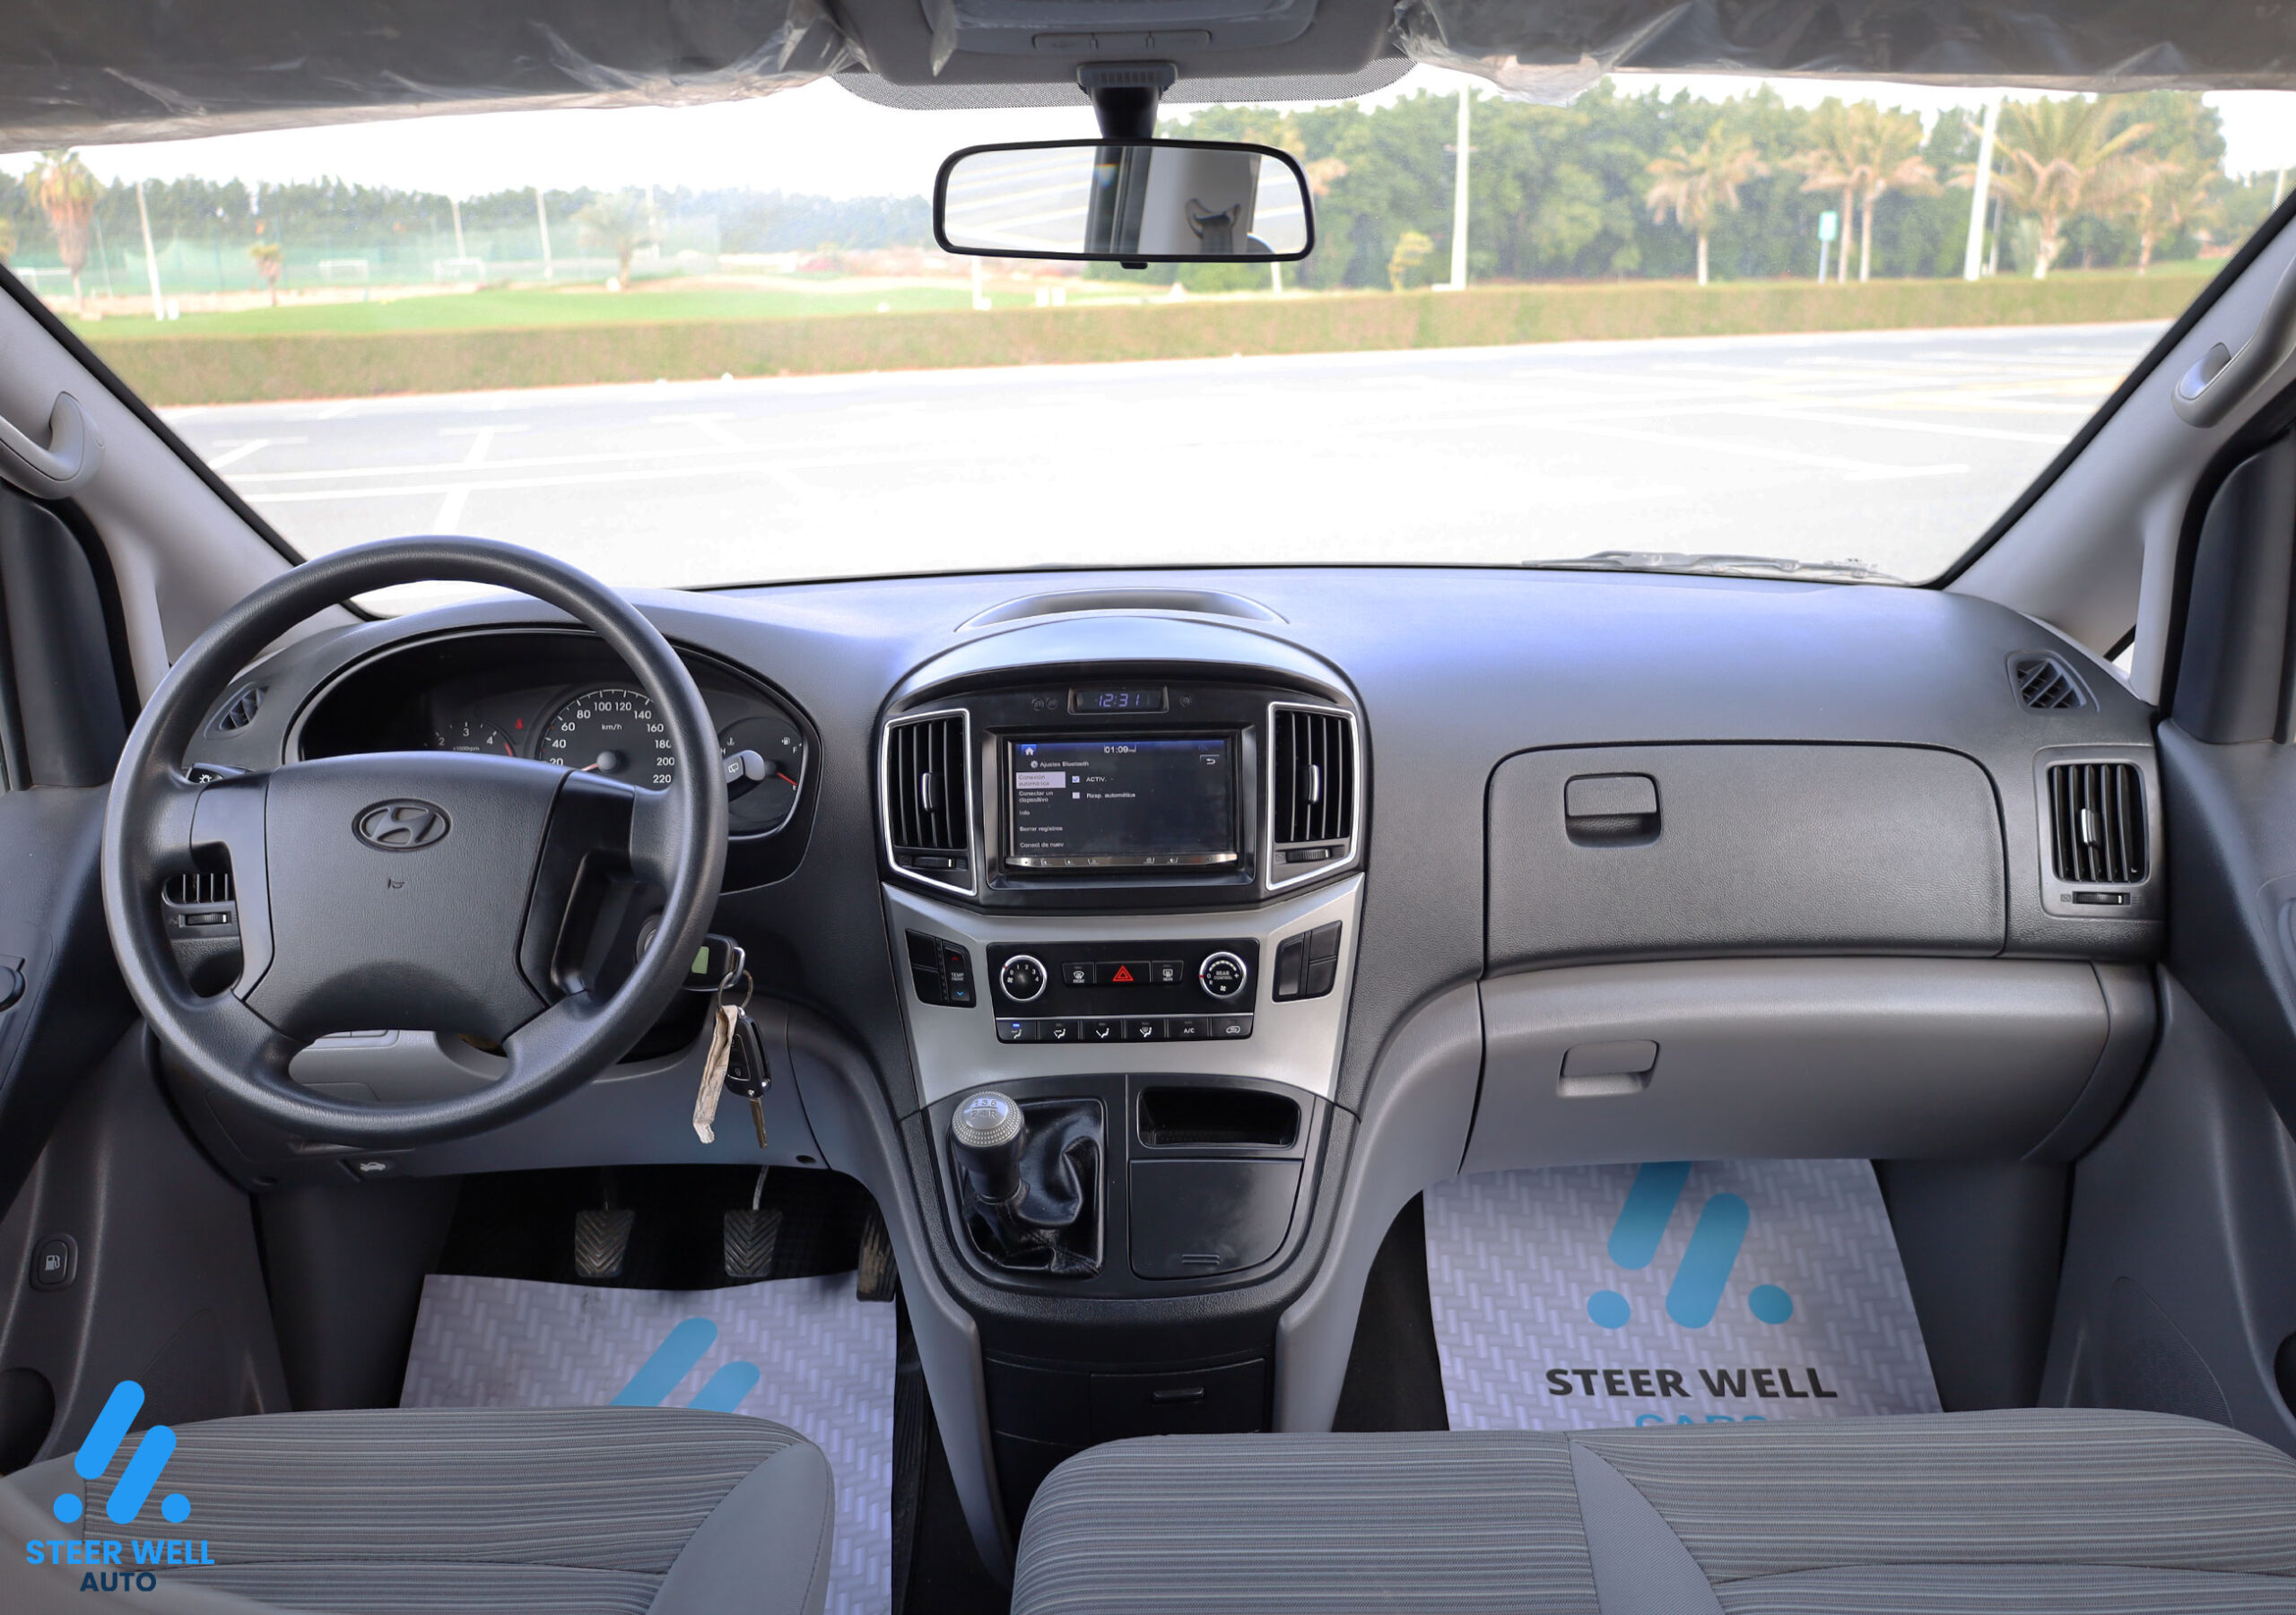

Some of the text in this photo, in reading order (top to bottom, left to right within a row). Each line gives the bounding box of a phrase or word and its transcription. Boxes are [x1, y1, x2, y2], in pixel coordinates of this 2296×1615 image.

[1099, 693, 1140, 708] 12:31
[594, 701, 612, 712] 100
[614, 701, 632, 711] 120
[577, 709, 591, 719] 80
[634, 710, 652, 719] 140
[462, 727, 470, 737] 3
[561, 722, 576, 732] 60
[646, 724, 665, 733] 160
[439, 737, 445, 746] 2
[486, 736, 493, 745] 4
[552, 739, 567, 749] 40
[655, 739, 672, 749] 180
[657, 757, 675, 766] 200
[653, 774, 672, 784] 220
[1545, 1368, 1839, 1398] STEER WELL
